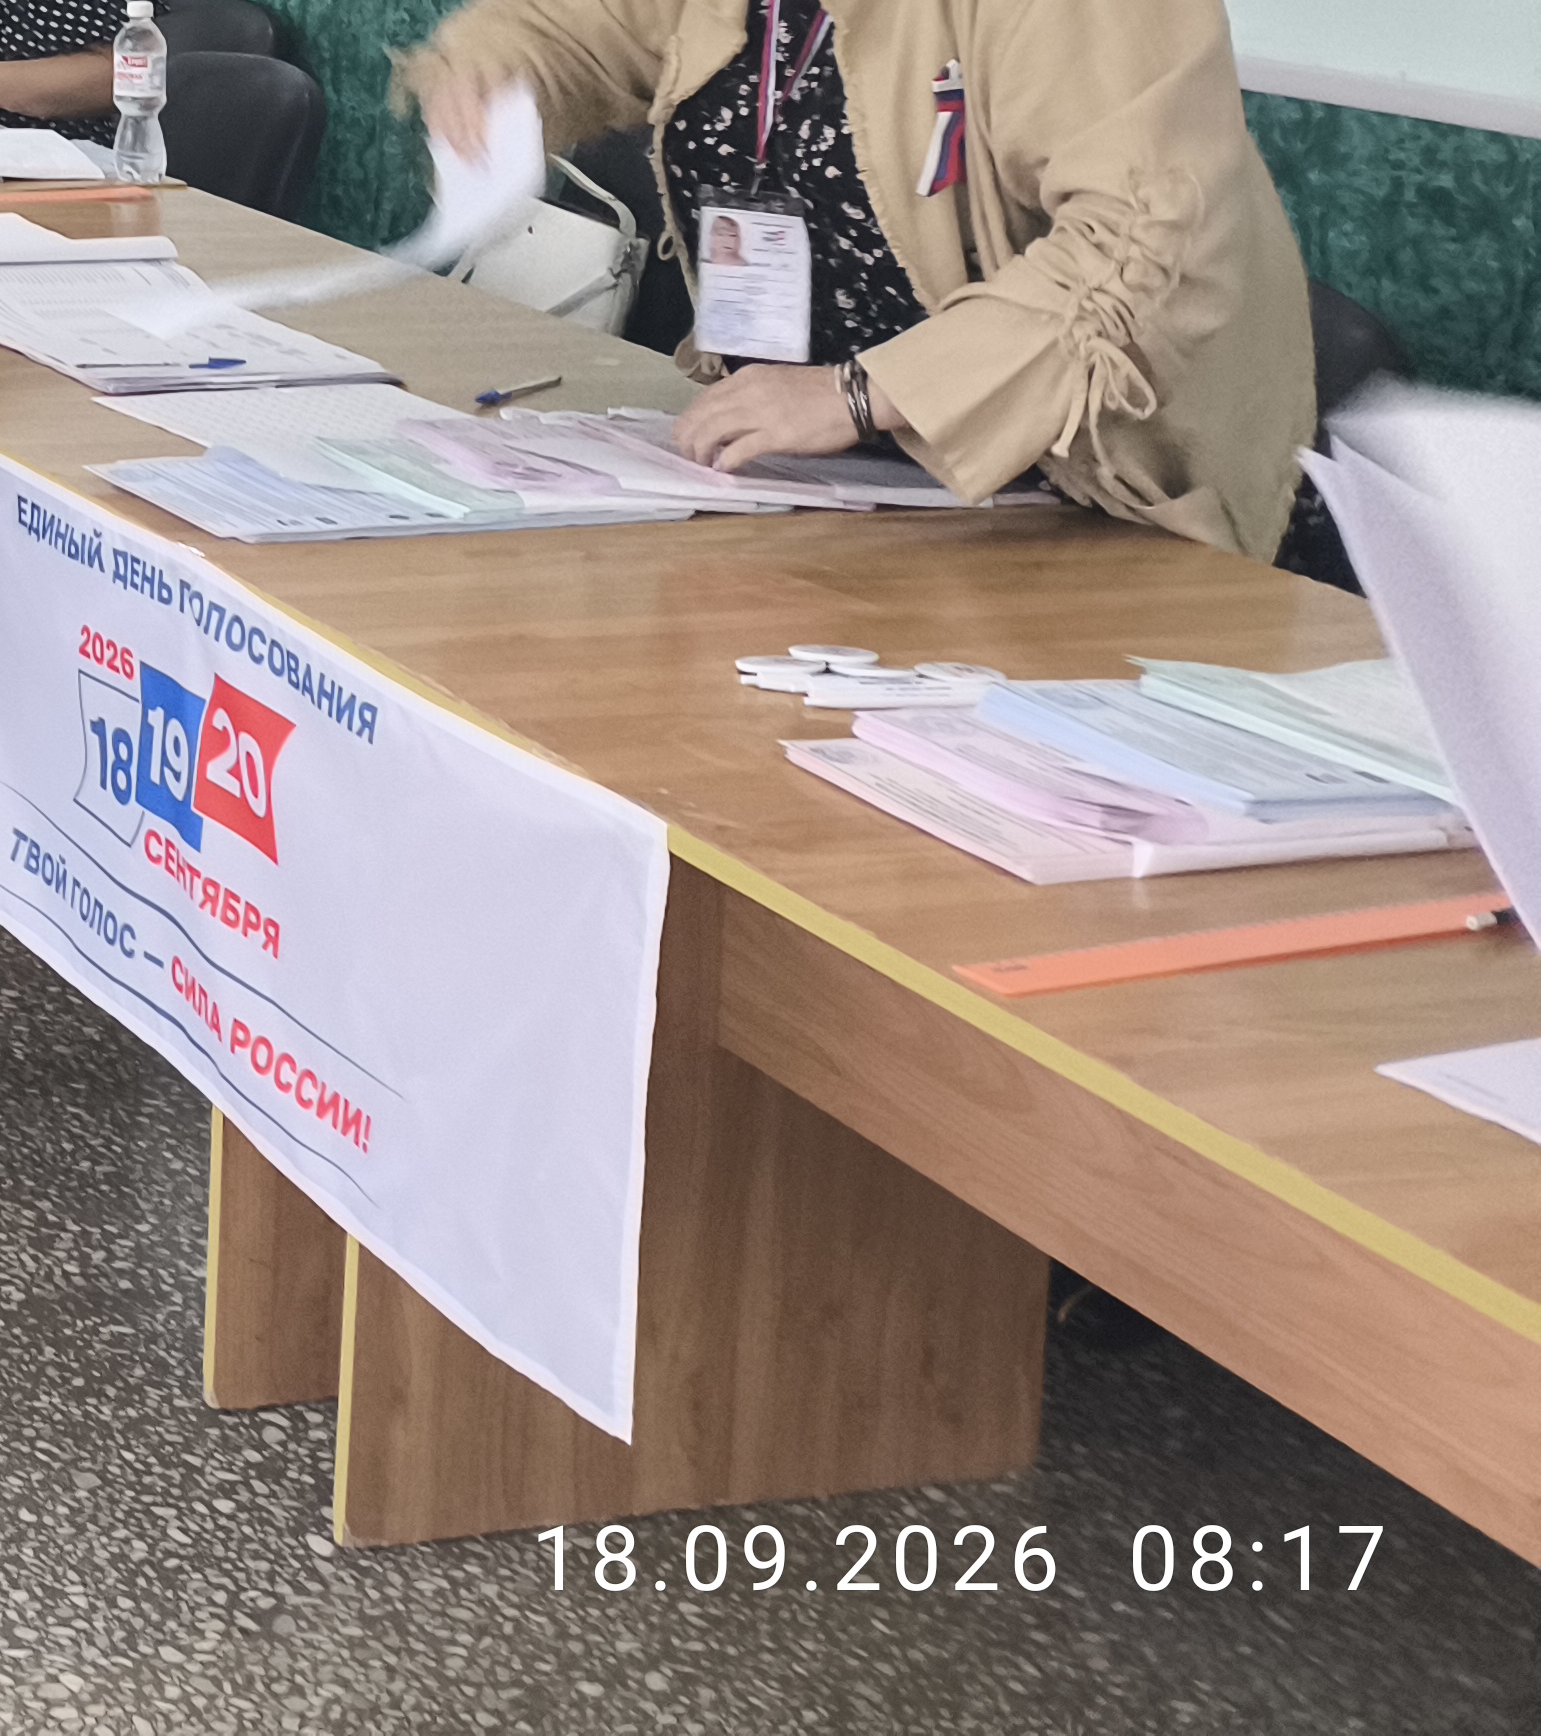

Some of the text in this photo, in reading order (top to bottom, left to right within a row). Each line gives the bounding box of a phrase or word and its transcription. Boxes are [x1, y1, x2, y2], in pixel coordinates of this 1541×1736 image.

[17, 494, 379, 746] ЕДИНЫЙ ДЕНЬ ГОЛОСОВАНИЯ
[78, 624, 135, 681] 2026
[89, 705, 268, 819] 18 19 20
[143, 828, 281, 960] СЕНТЯБРЯ
[9, 827, 67, 904] ТВОЙ
[70, 876, 137, 959] ГОЛОС
[170, 955, 224, 1045] СИЛА
[229, 1017, 372, 1155] РОССИИ!
